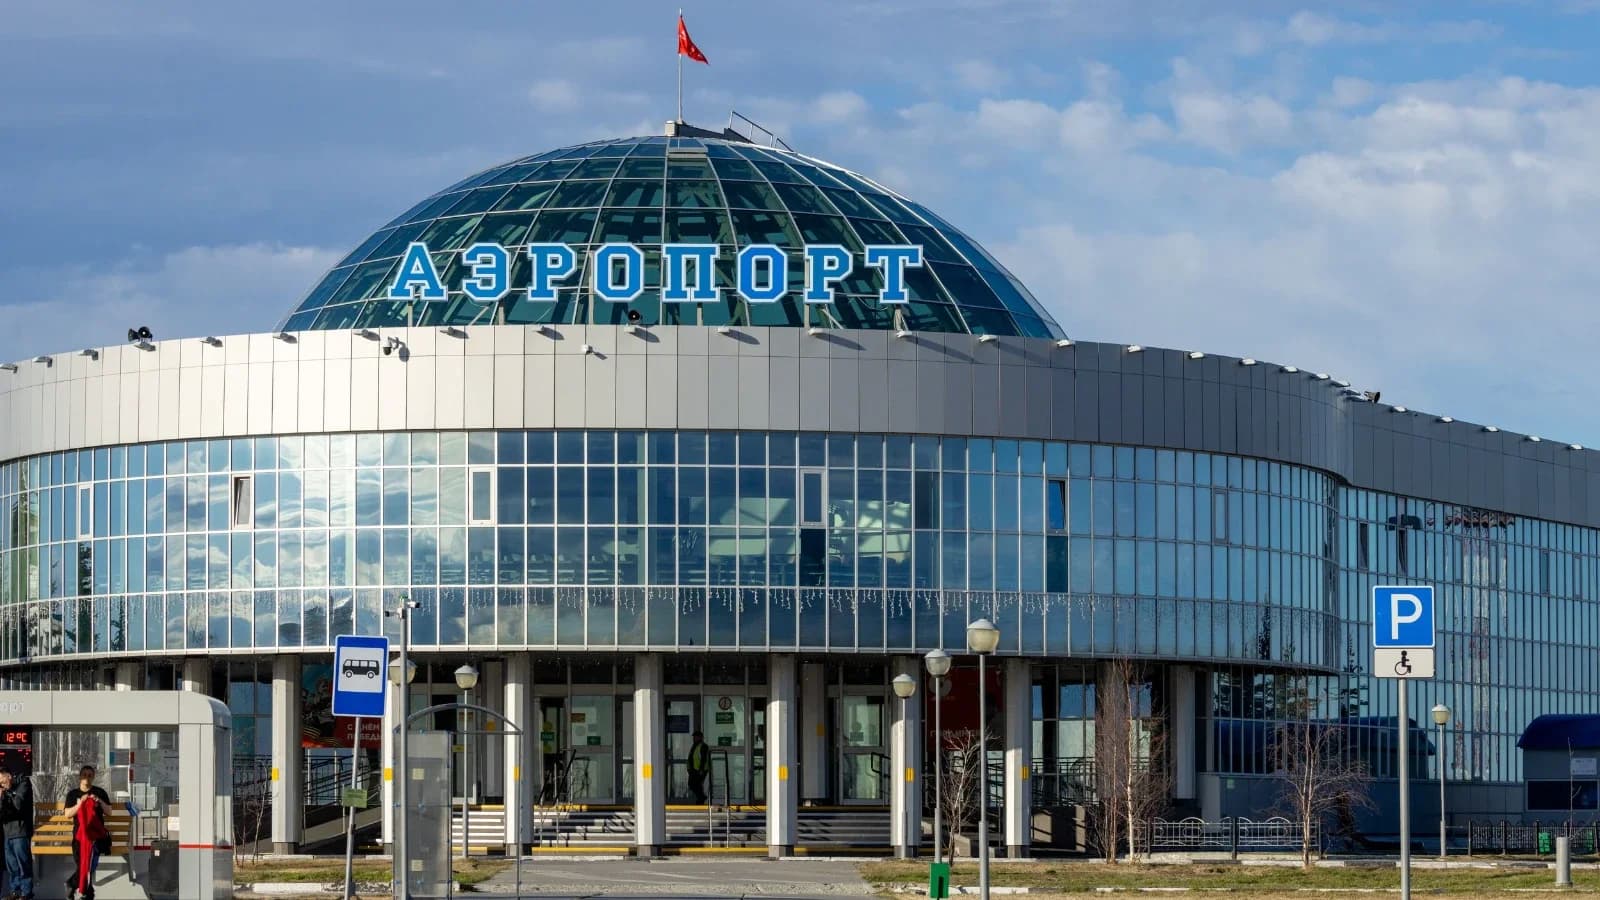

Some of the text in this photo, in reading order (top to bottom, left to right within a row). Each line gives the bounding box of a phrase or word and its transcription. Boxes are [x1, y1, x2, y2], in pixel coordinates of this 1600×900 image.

[387, 241, 924, 304] АЭРОПОРТ
[1391, 593, 1423, 640] P
[357, 723, 380, 731] НЁМ
